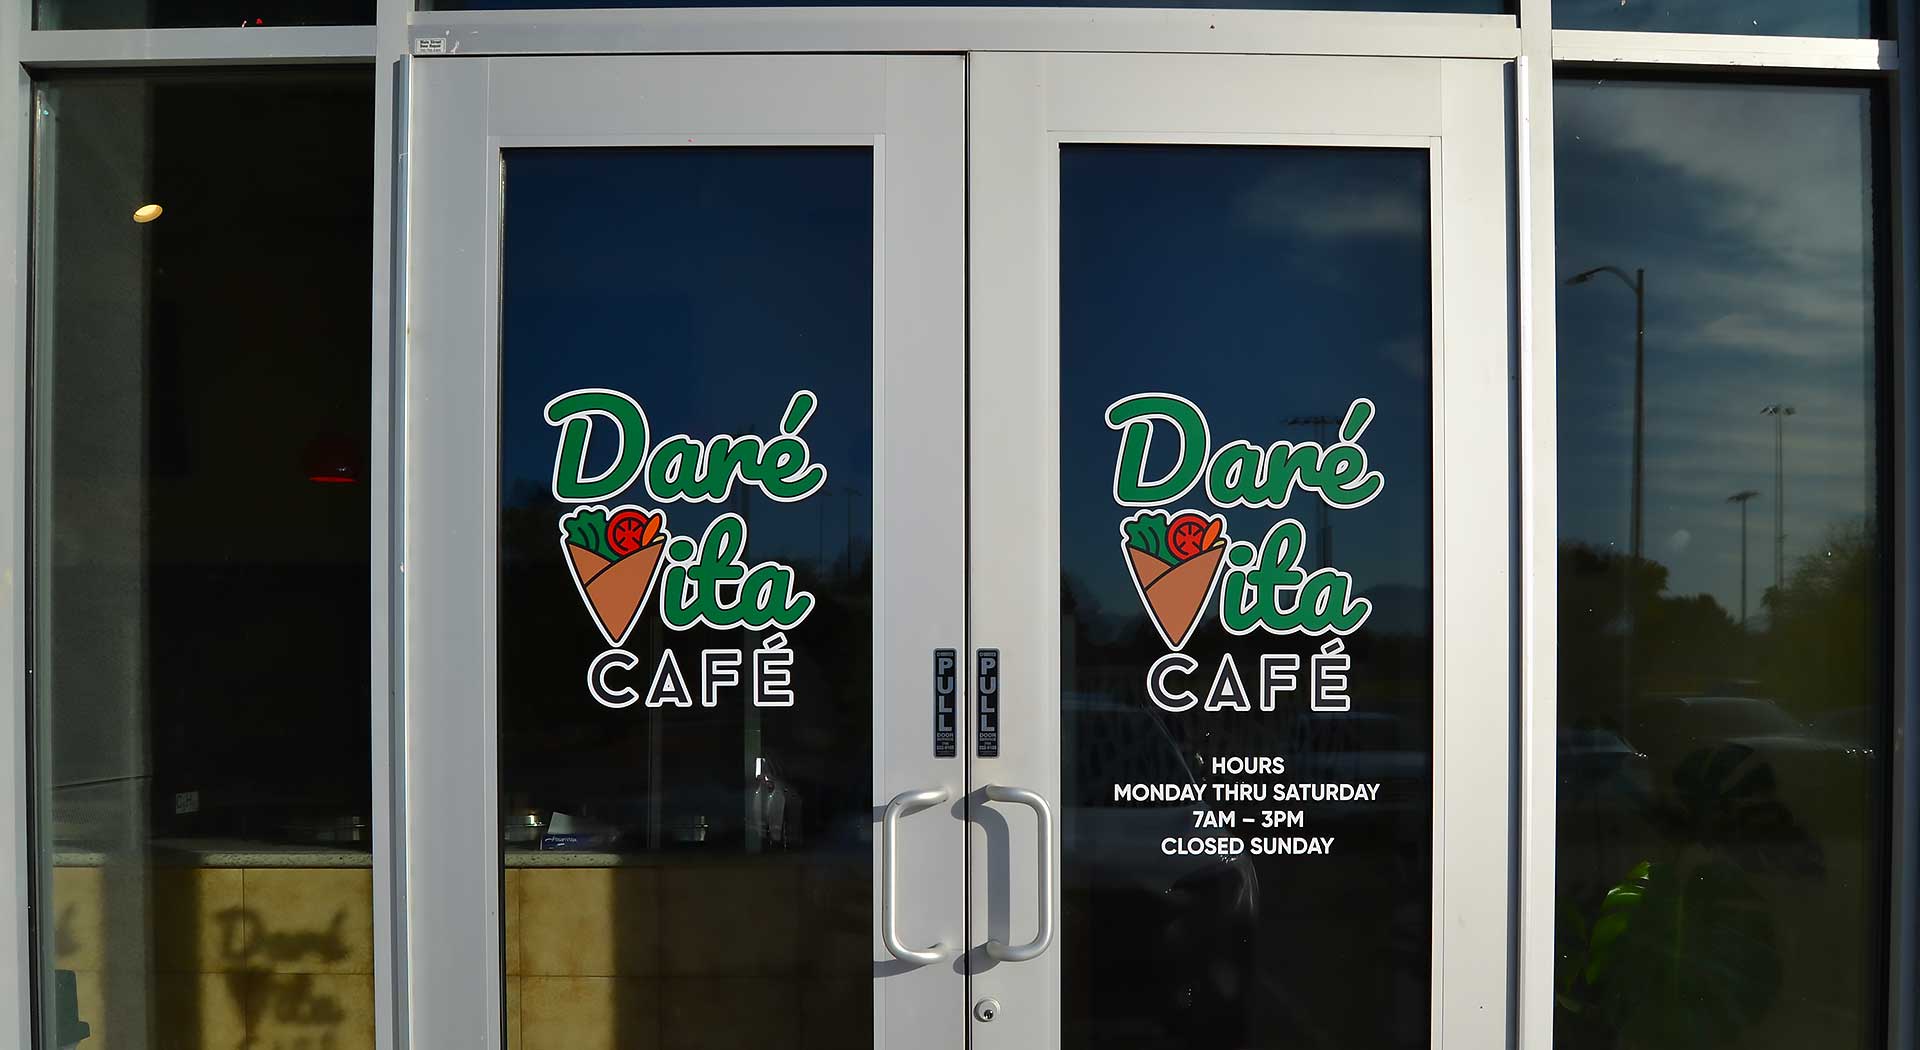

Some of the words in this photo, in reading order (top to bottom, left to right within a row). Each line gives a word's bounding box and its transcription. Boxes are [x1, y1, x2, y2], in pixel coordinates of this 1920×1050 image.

[544, 388, 827, 502] Daré
[1105, 392, 1385, 509] Daré
[587, 632, 794, 708] CAFÉ
[937, 658, 954, 732] PULL
[979, 658, 997, 732] PULL
[1147, 637, 1351, 712] CAFÉ
[1114, 783, 1205, 801] MONDAY
[1212, 783, 1267, 801] THRU
[1273, 783, 1380, 801] SATURDAY
[1212, 756, 1285, 774] HOURS
[1161, 837, 1244, 855] CLOSED
[1250, 837, 1334, 855] SUNDAY
[1192, 810, 1236, 828] 7AM
[1261, 810, 1304, 828] 3PM
